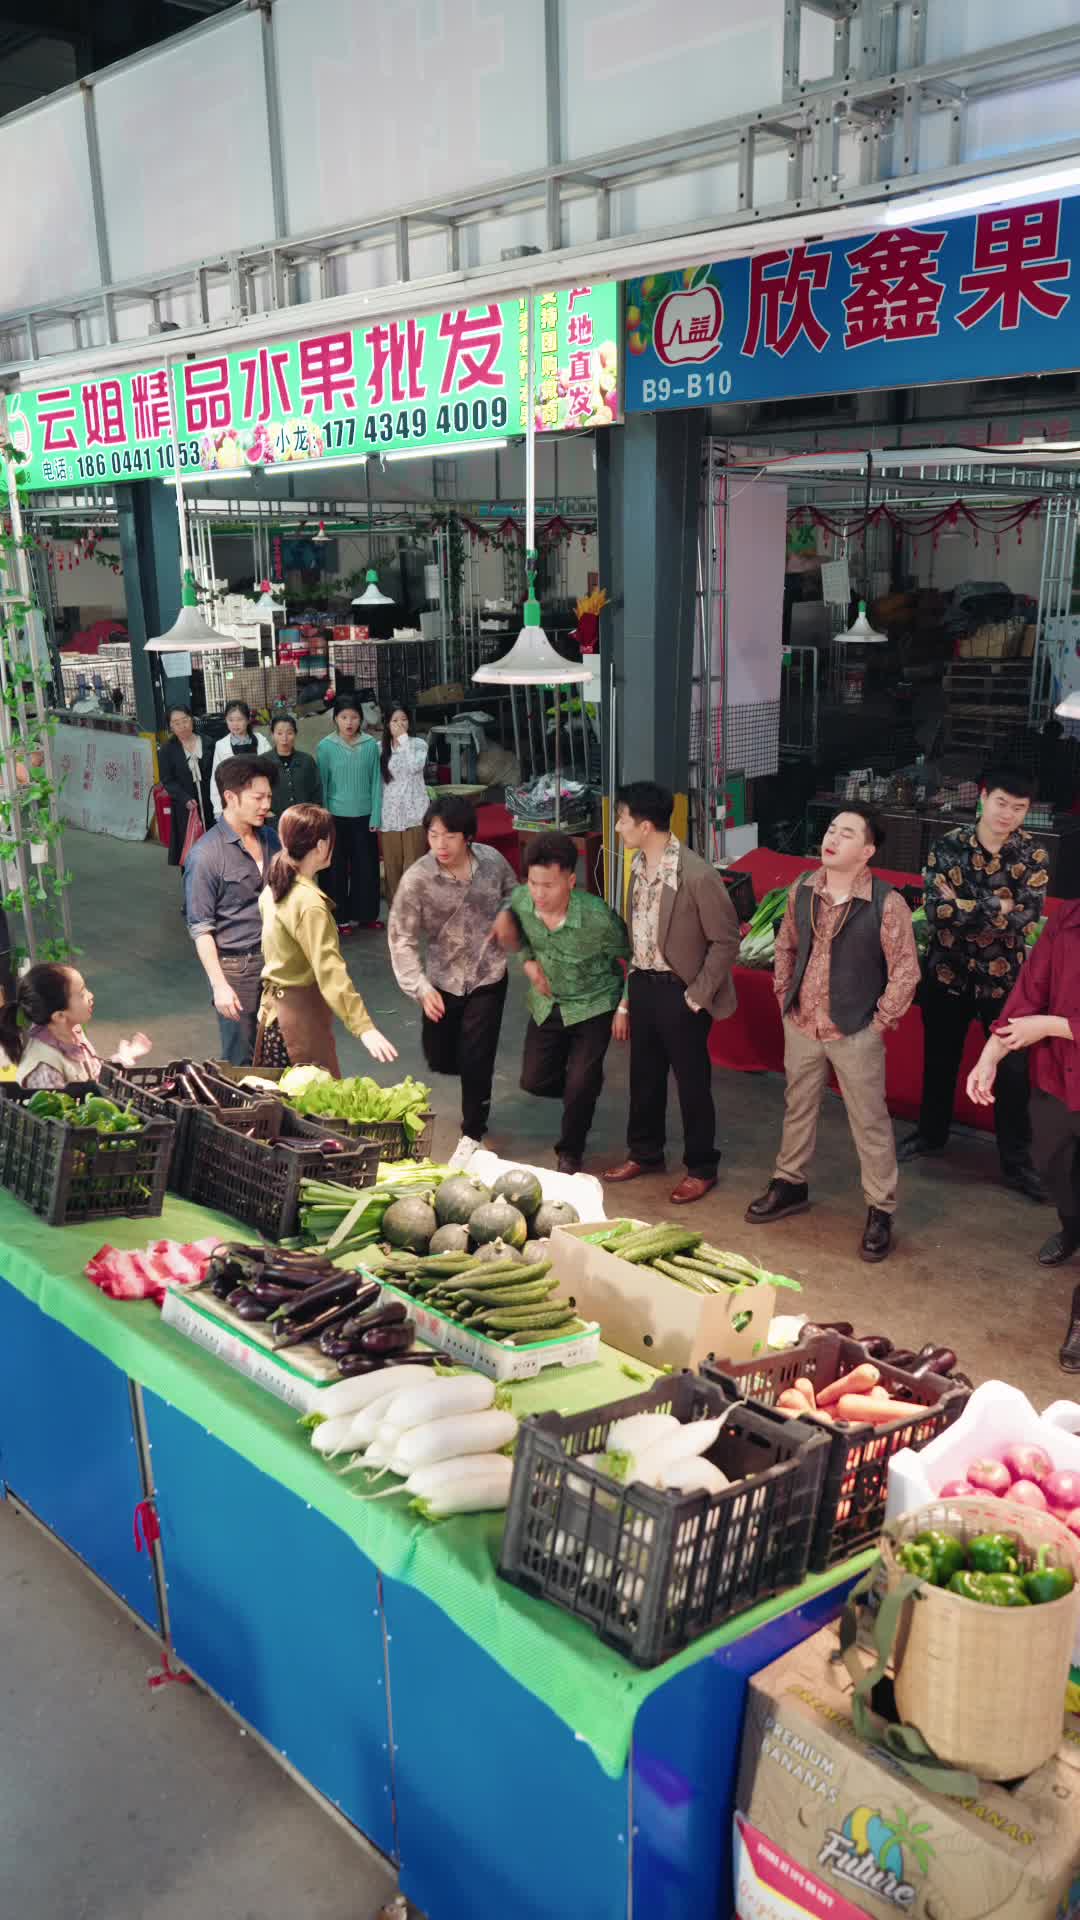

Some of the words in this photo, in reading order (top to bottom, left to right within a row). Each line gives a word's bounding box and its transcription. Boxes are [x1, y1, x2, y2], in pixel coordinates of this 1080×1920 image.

[740, 199, 1071, 357] 欣鑫果
[37, 302, 504, 451] 云姐精品水果批发
[642, 370, 732, 403] B9-B10
[322, 418, 356, 449] 177
[364, 408, 427, 442] 4349
[436, 396, 508, 432] 4009
[77, 452, 106, 477] 186
[112, 447, 151, 474] 0441
[157, 440, 201, 469] 1053
[761, 1736, 838, 1803] BANANAS
[765, 1717, 833, 1777] PREMIUM
[818, 1829, 916, 1905] Future
